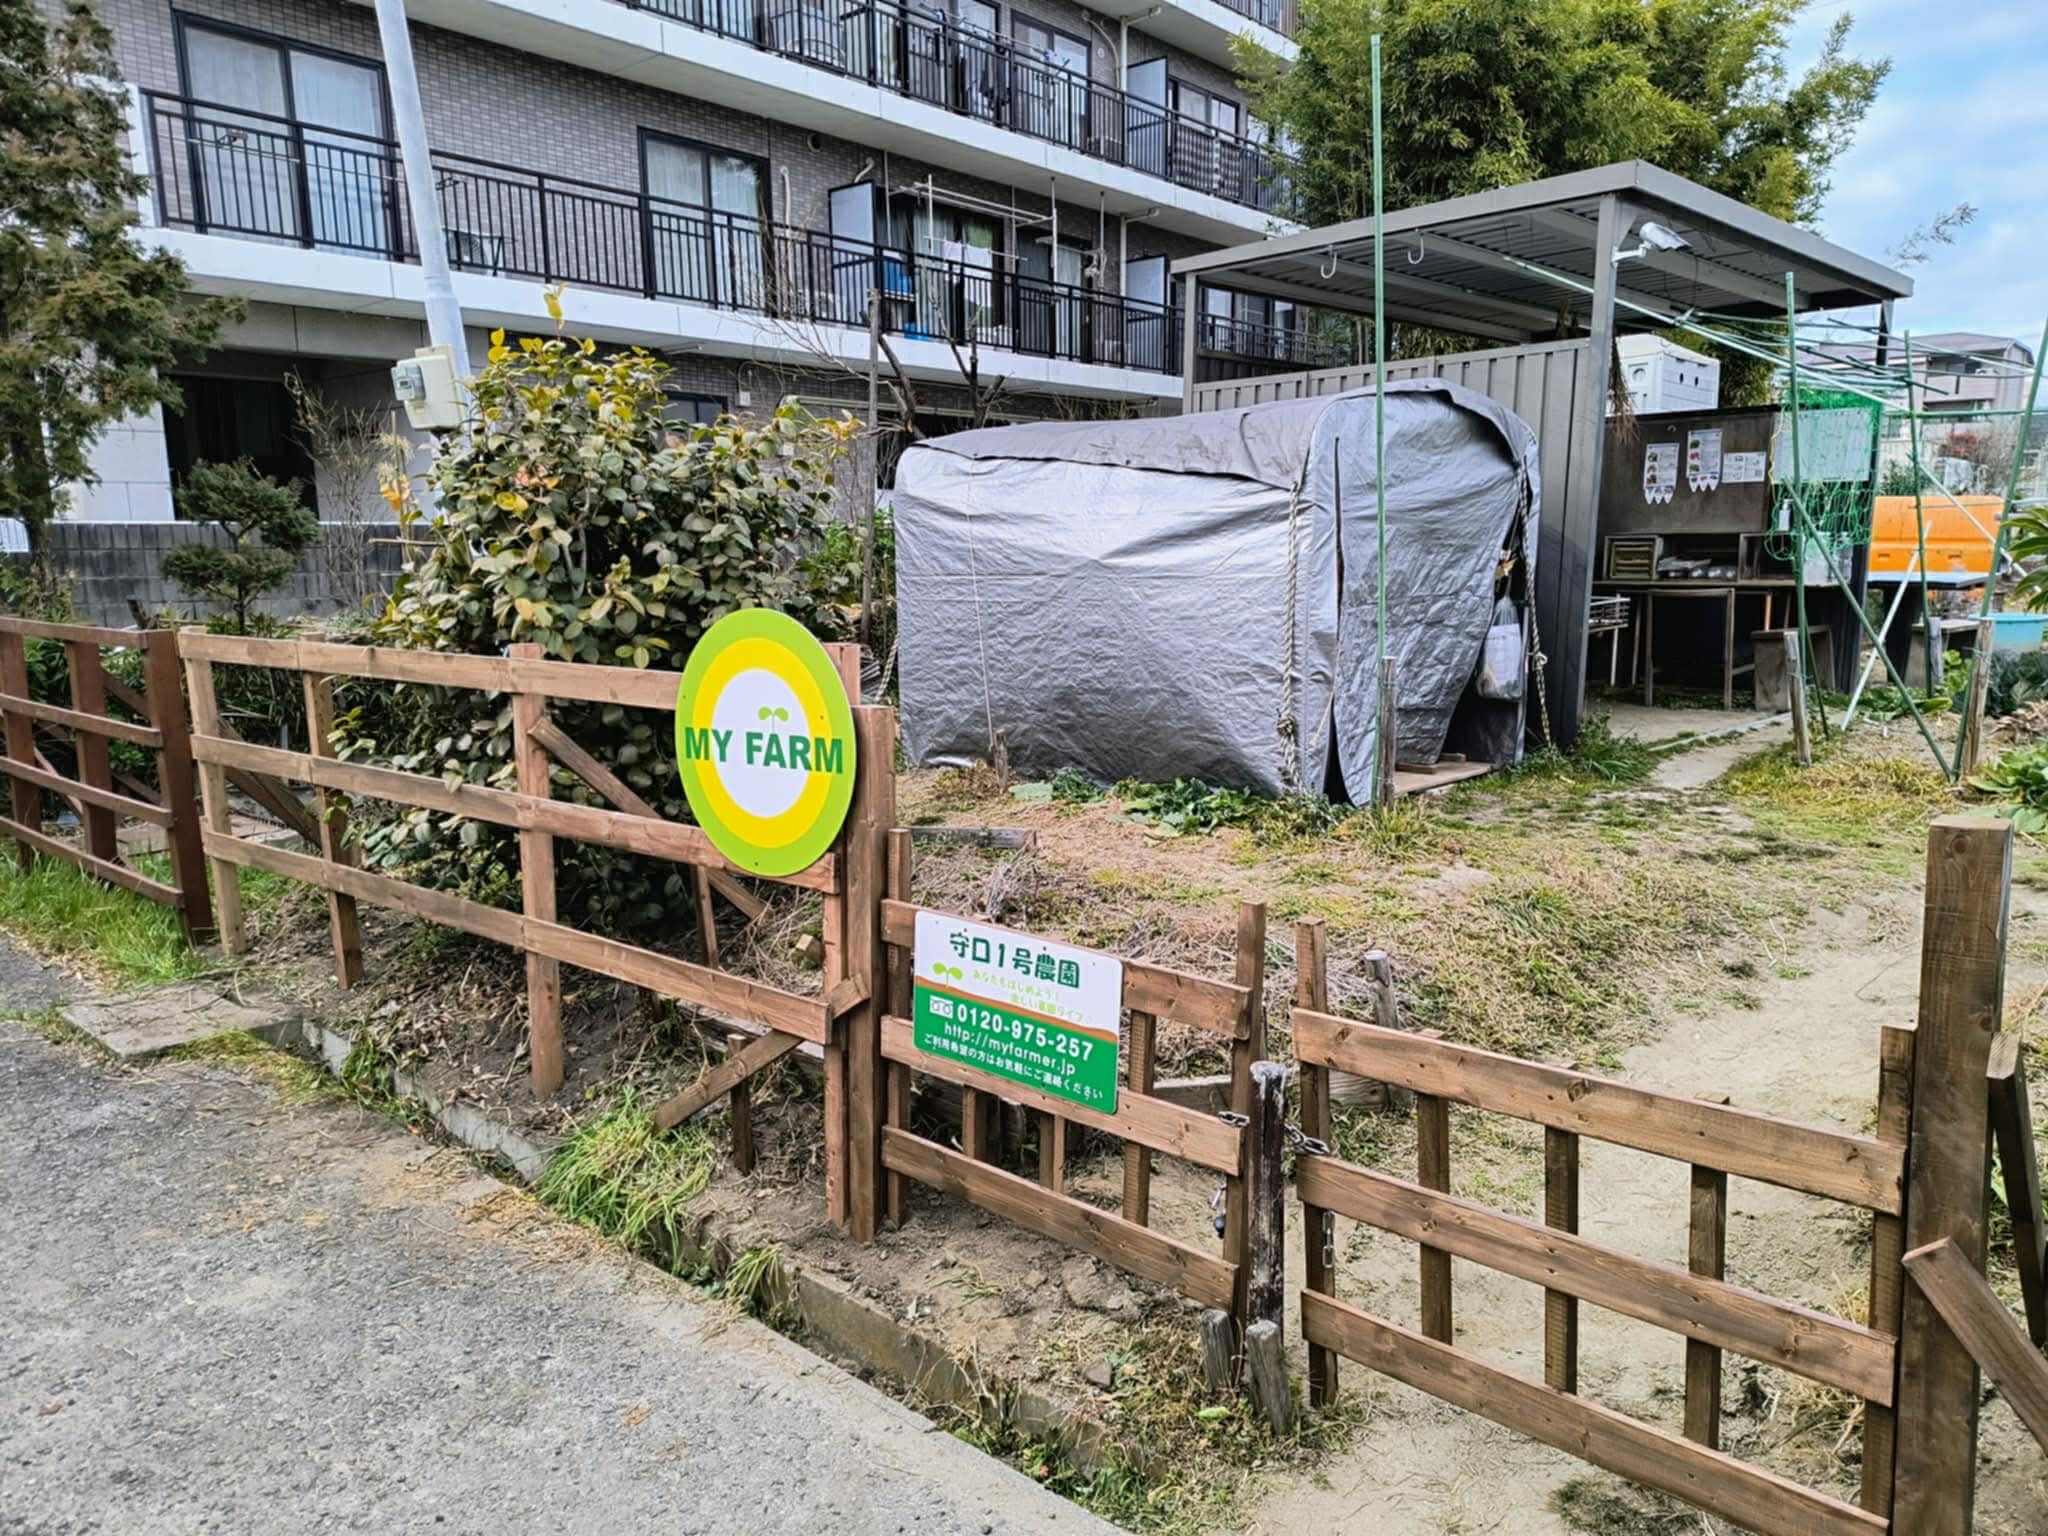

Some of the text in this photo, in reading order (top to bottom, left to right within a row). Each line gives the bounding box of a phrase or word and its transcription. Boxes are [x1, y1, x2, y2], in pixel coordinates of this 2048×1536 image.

[684, 727, 843, 774] MY FARM
[944, 1022, 1075, 1075] http://myfarmer.jp
[957, 1003, 1093, 1061] 0120-975-257
